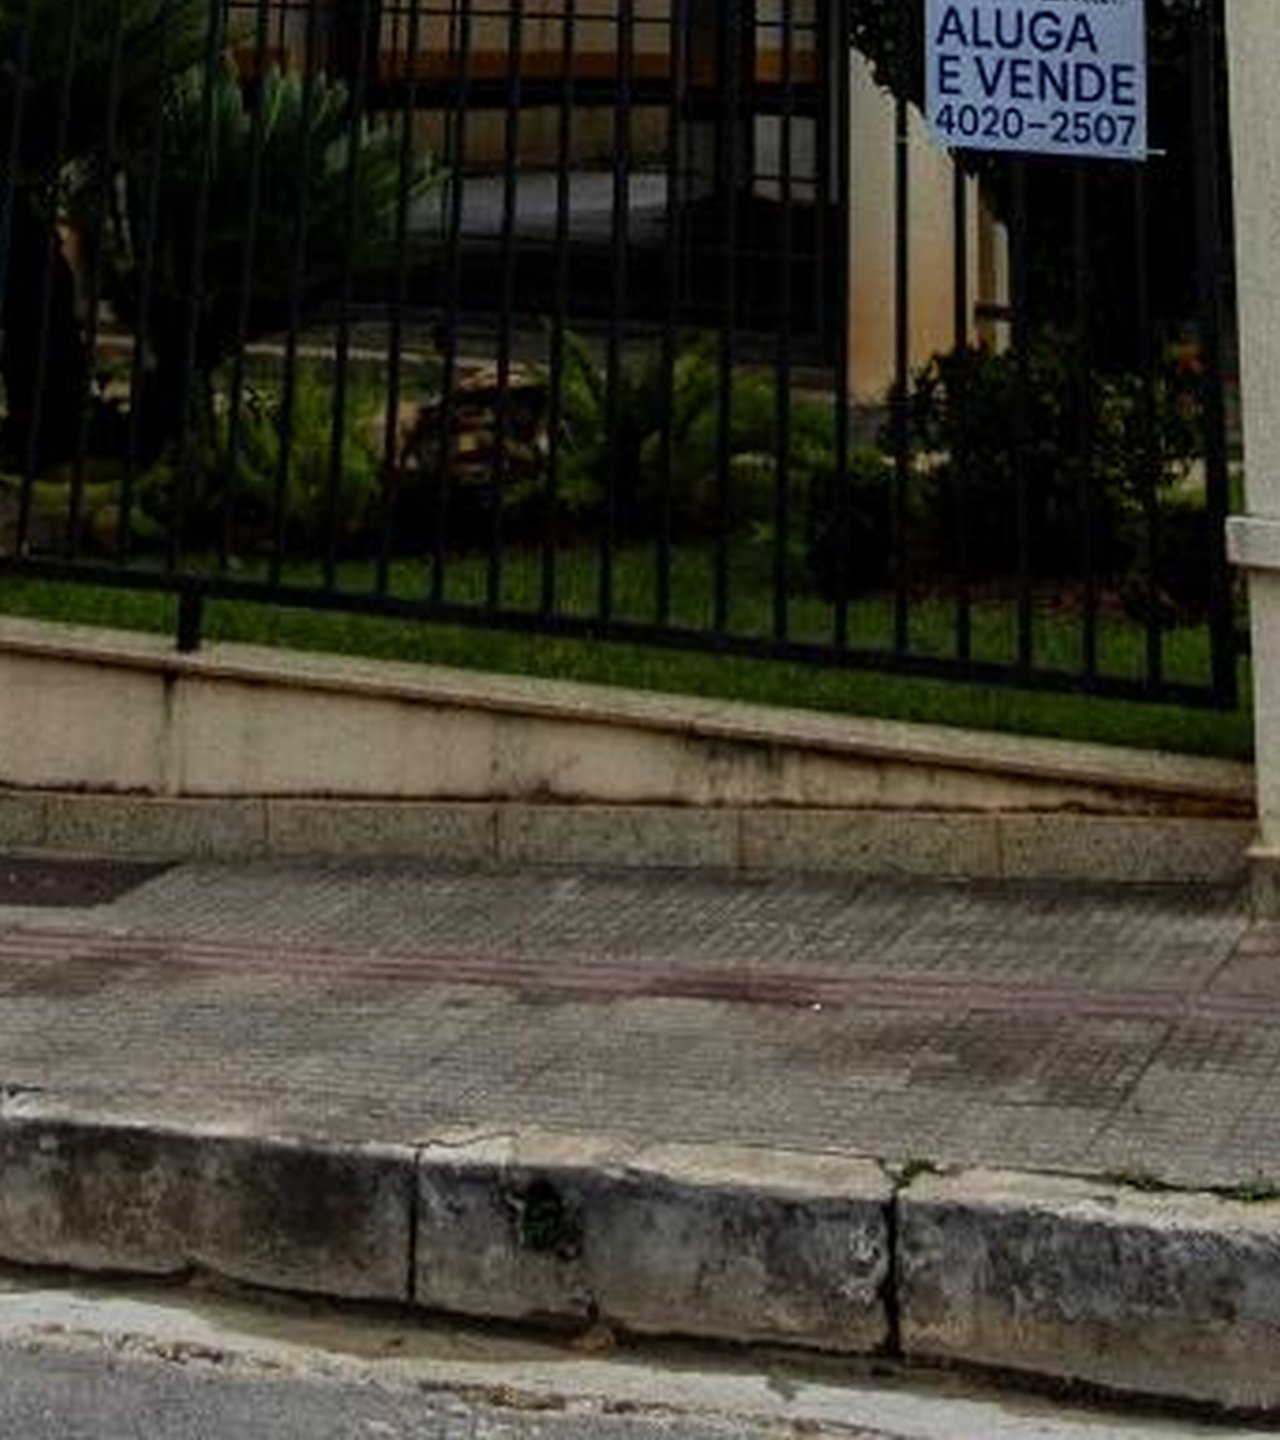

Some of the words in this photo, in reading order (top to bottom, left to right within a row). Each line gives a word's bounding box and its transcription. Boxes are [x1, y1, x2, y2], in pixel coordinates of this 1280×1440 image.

[935, 6, 1098, 54] ALUGA
[938, 55, 961, 95] E
[975, 57, 1137, 107] VENDE
[934, 104, 1136, 147] 4020-2507
